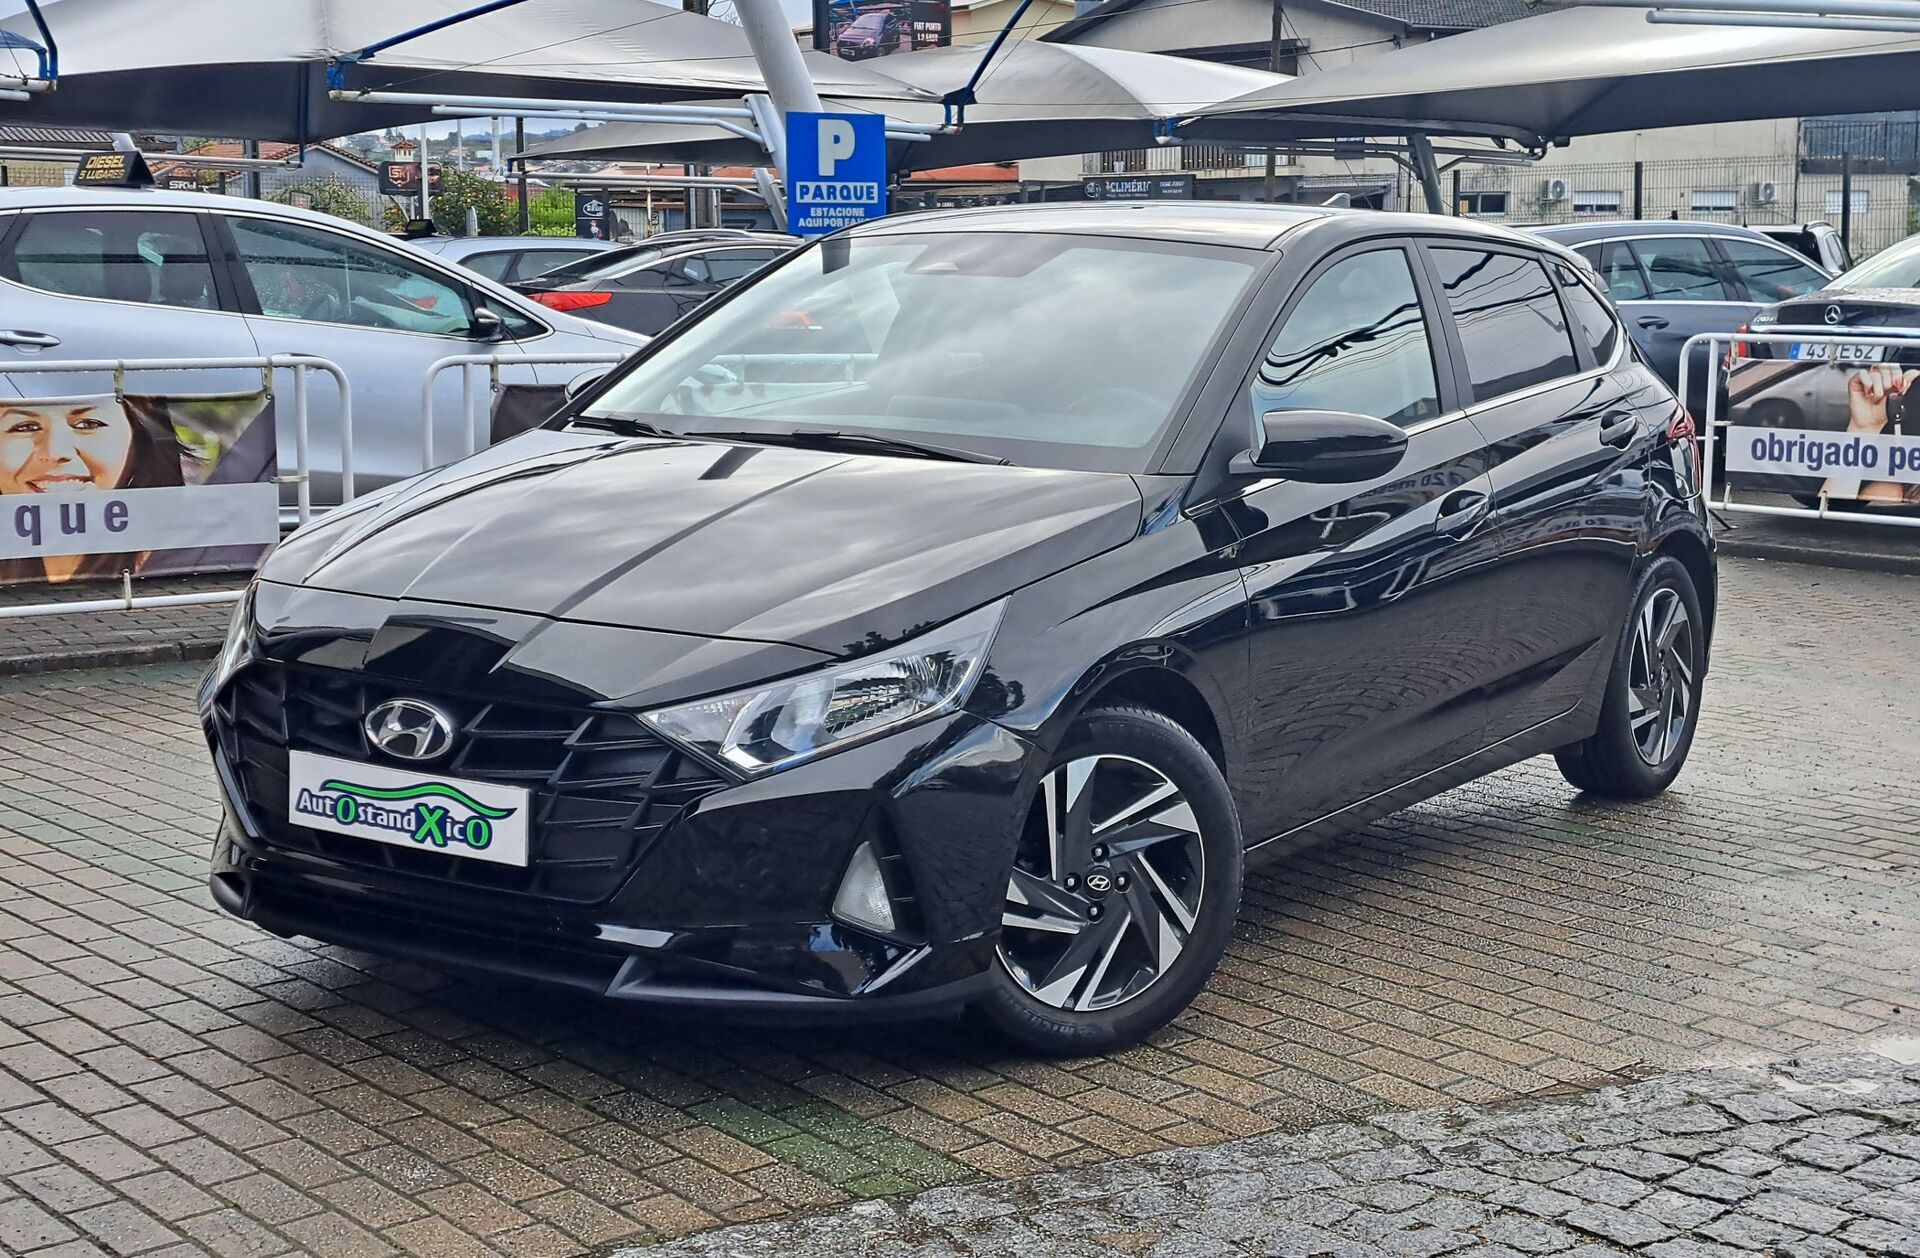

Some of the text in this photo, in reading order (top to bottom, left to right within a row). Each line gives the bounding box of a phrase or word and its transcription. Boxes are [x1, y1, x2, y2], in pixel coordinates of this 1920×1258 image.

[817, 118, 856, 177] P
[85, 155, 125, 169] DIESEL
[799, 184, 876, 201] PARQUE
[810, 206, 865, 217] ESTACIONE
[798, 217, 823, 228] AQUI
[1751, 432, 1878, 472] obrigado
[14, 500, 129, 546] que
